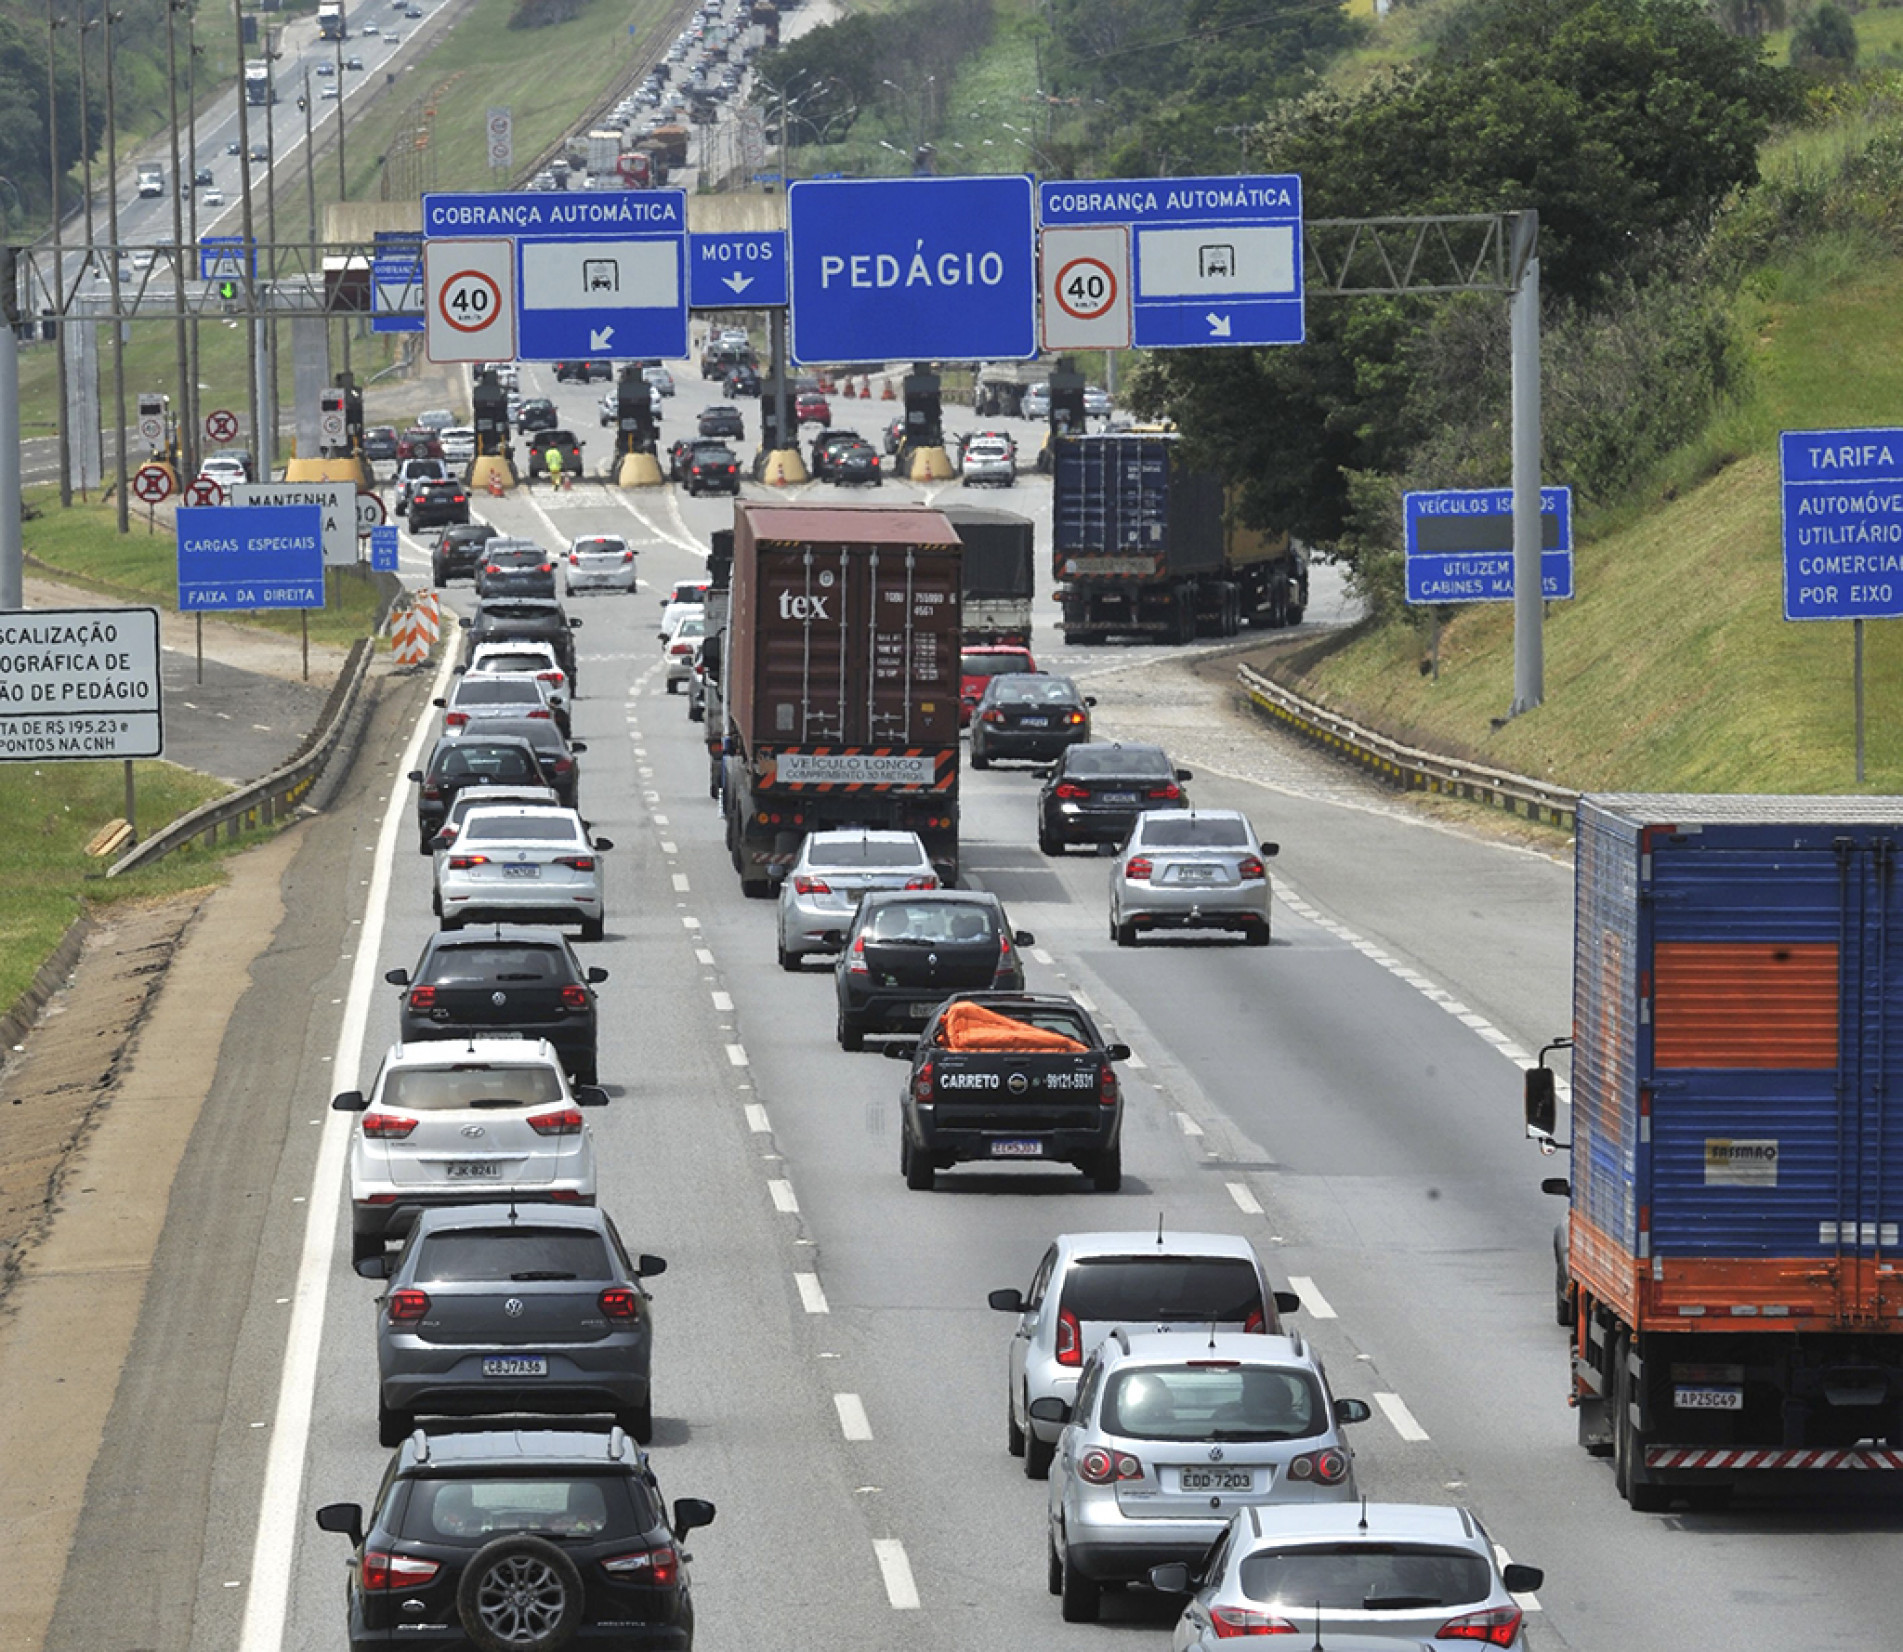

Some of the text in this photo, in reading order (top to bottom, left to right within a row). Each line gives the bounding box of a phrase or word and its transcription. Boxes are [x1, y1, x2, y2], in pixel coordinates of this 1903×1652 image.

[1050, 183, 1291, 213] COBRANÇA AUTOMÁTICA
[432, 197, 677, 227] COBRANÇA AUTOMÁTICA
[702, 242, 773, 261] MOTOS
[821, 238, 1003, 289] PEDÁGIO
[1068, 275, 1104, 299] 40
[452, 288, 488, 312] 40
[1808, 446, 1894, 469] TARIFA
[249, 494, 338, 507] MANTENHA
[1418, 496, 1555, 514] VEÍCULOS ISOS
[1799, 520, 1901, 545] UTILITÁRIO
[184, 537, 315, 553] CARGAS ESPECIAIS
[1444, 561, 1509, 576] UTILIZEM
[1421, 576, 1558, 595] CABINES MAIS
[1799, 584, 1893, 604] POR EIXO
[188, 588, 315, 604] FAIXA DA DIREITA
[779, 588, 830, 619] tex
[0, 651, 131, 673] OGRÁFICA DE
[31, 684, 56, 701] DE
[62, 676, 149, 700] PEDÁGIO
[22, 721, 42, 735] DE
[59, 737, 80, 751] NA
[83, 736, 116, 750] CNH
[790, 757, 923, 771] VEÍCULO LONGO
[940, 1074, 999, 1089] CARRETO
